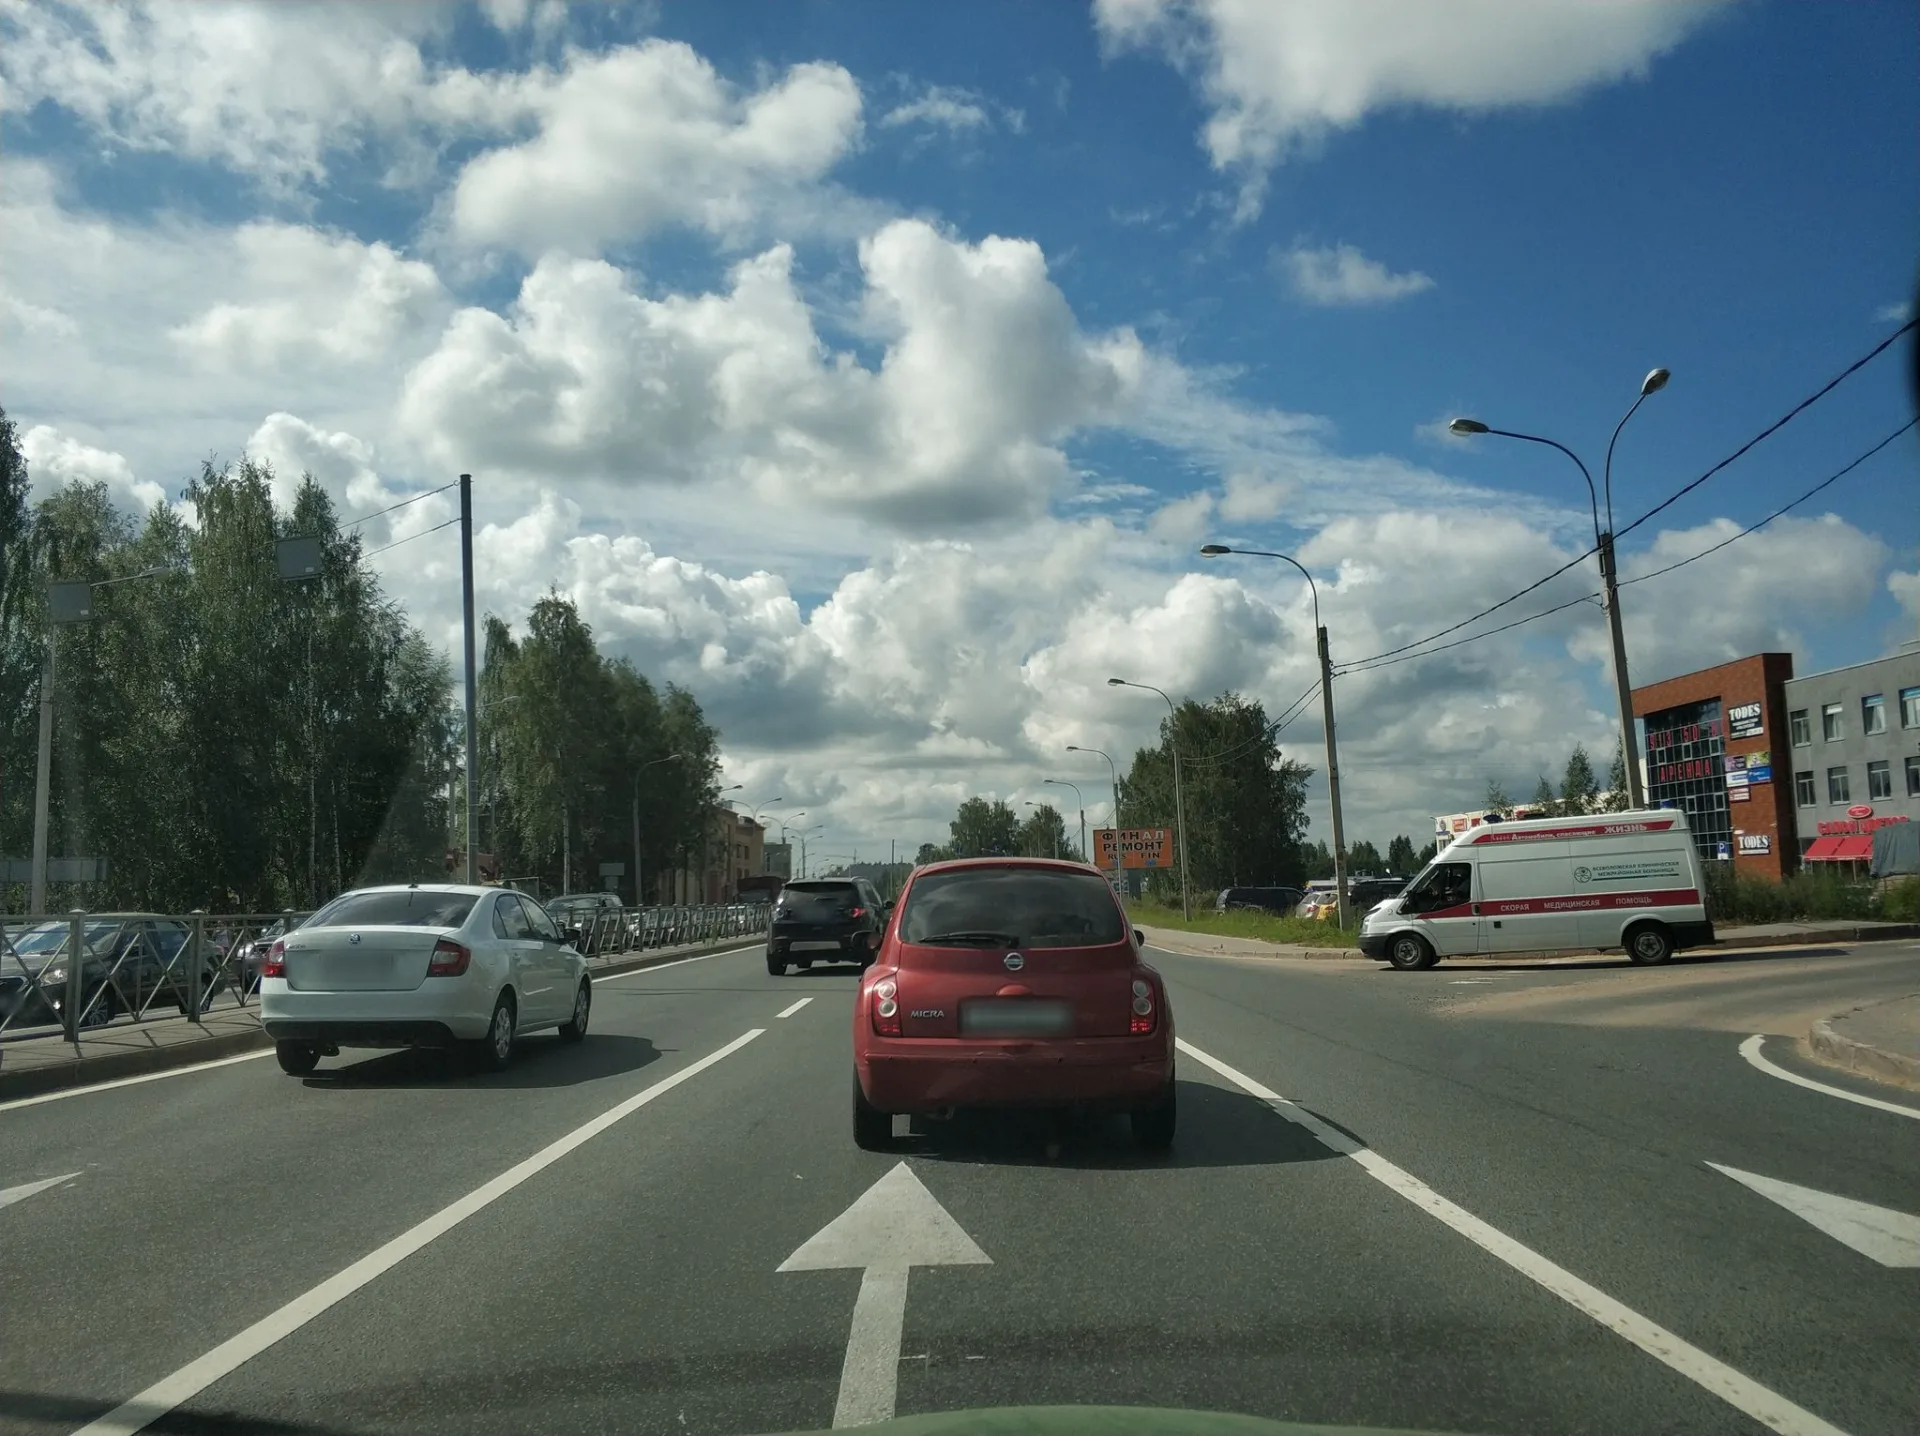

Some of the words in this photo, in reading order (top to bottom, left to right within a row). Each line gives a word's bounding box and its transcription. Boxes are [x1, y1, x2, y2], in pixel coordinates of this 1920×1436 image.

[1729, 703, 1761, 721] TODES
[1660, 759, 1710, 783] АРЕНДА
[1603, 823, 1648, 835] ЖИЗНЬ
[1103, 841, 1164, 852] РЕМОНТ
[1738, 835, 1769, 849] TODES
[1500, 903, 1530, 912] СКОРАЯ
[1543, 899, 1600, 910] МЕДИЦИНСКАЯ
[1615, 897, 1653, 906] ПОМОЩЬ
[910, 1010, 945, 1019] MICRA
